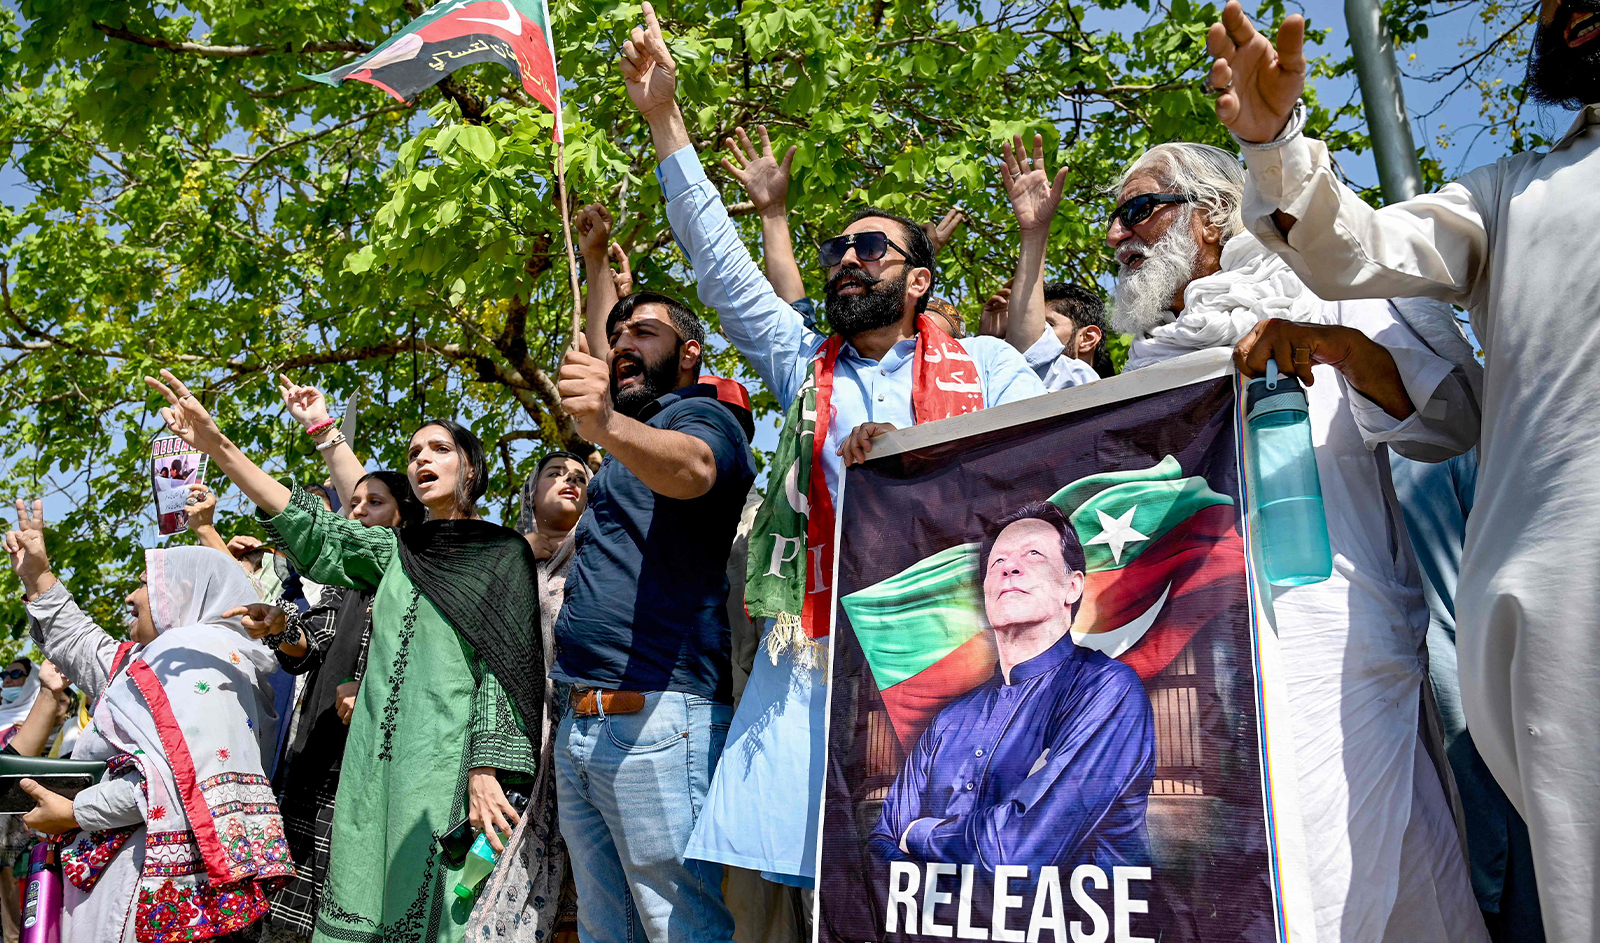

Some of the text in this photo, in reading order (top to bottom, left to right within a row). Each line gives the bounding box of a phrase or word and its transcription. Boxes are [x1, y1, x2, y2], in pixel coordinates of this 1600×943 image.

[153, 437, 197, 456] RELEA
[762, 531, 830, 594] PI
[885, 860, 1155, 943] RELEASE
